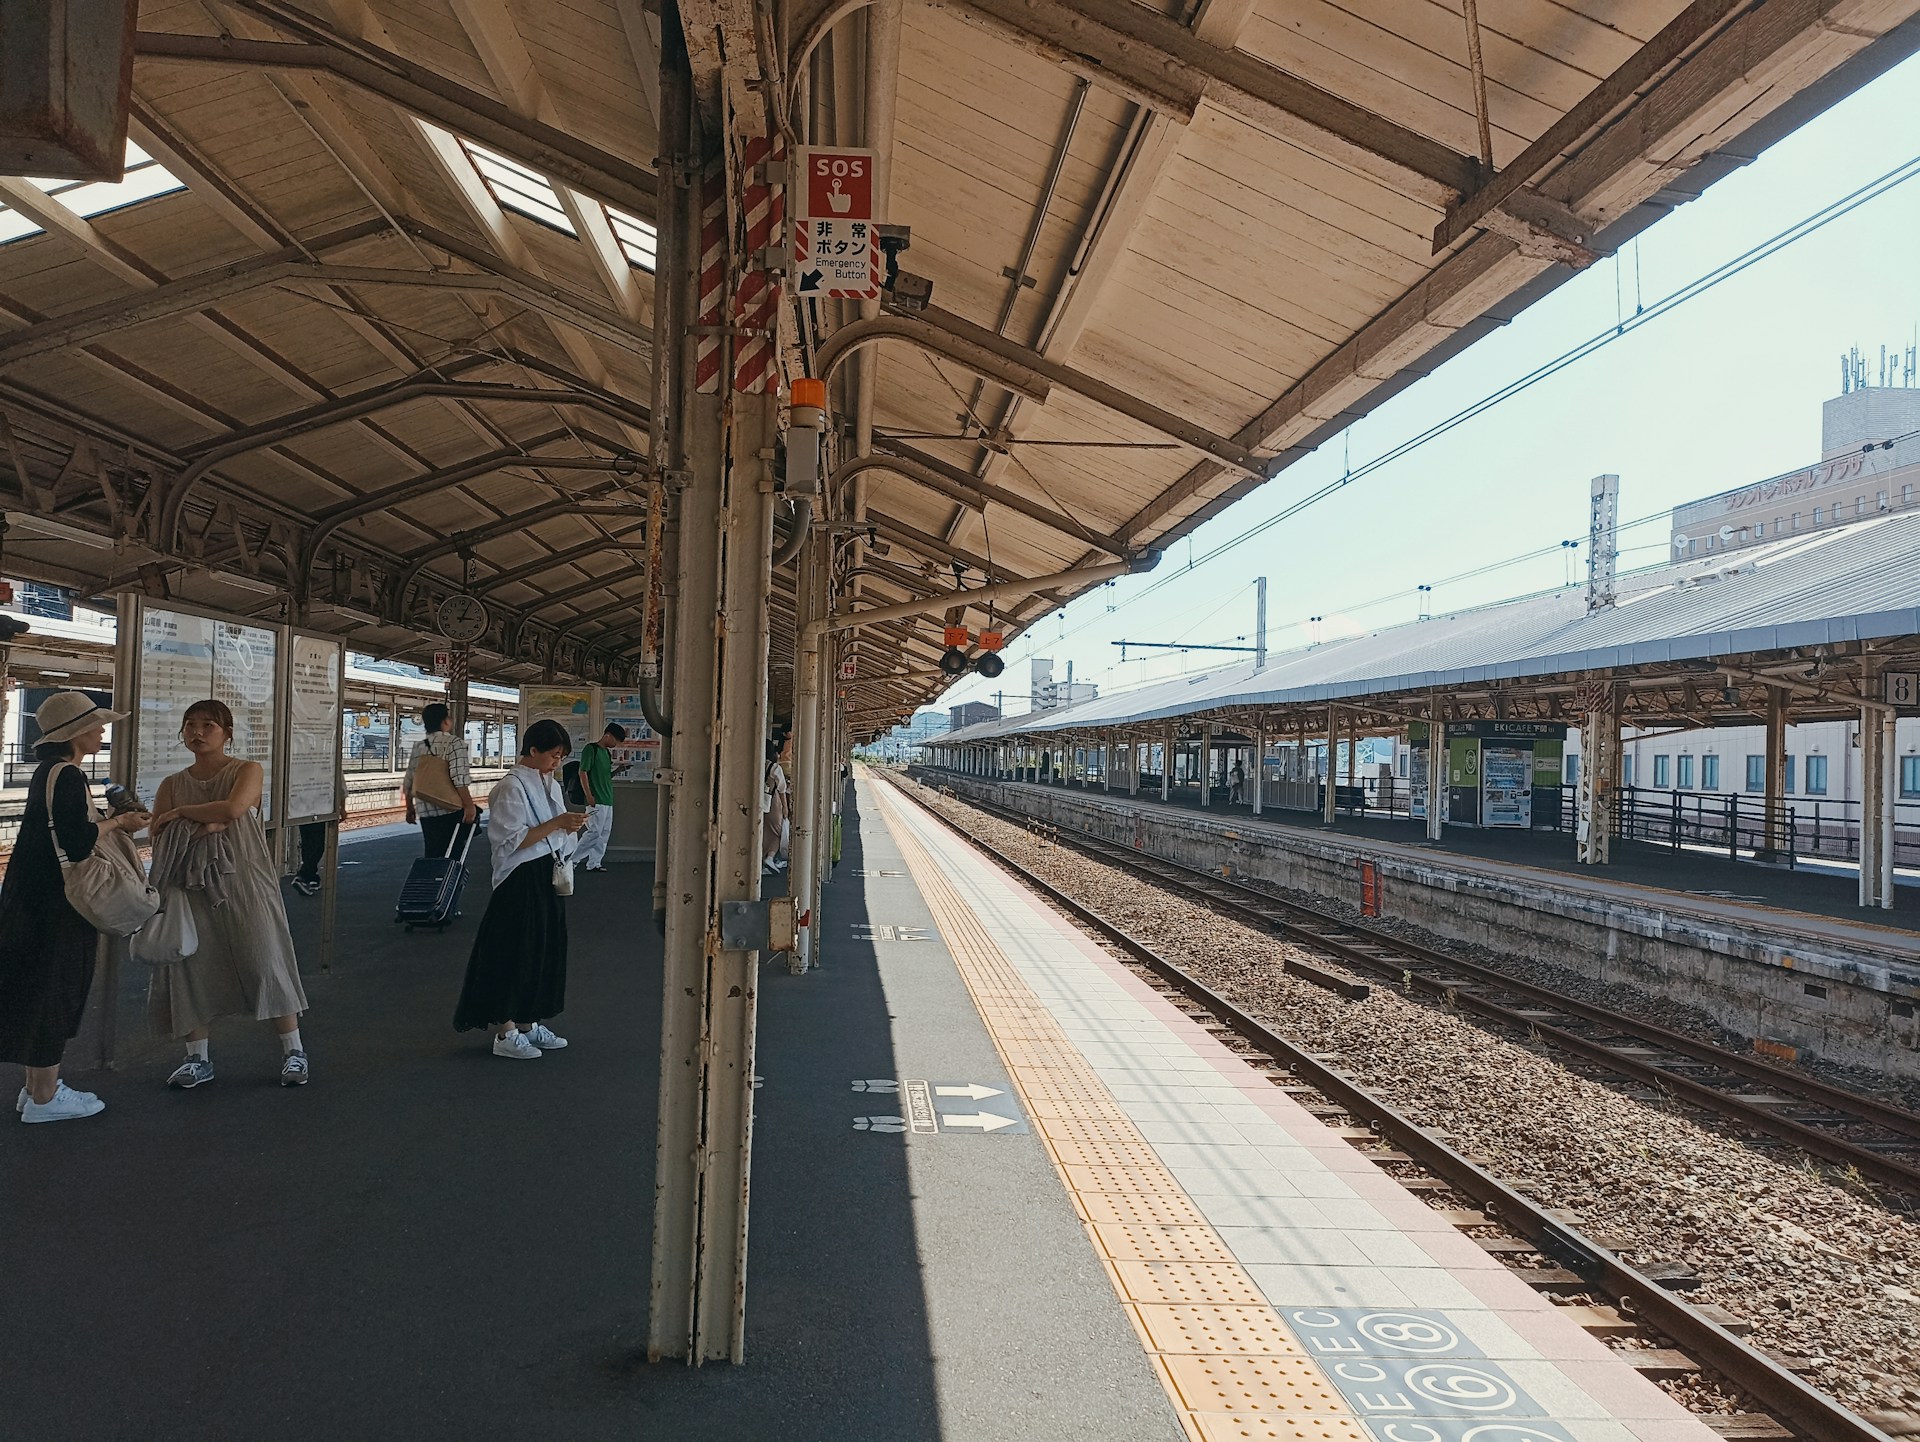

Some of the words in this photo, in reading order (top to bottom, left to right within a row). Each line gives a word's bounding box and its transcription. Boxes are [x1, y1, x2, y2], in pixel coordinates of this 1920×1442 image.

[817, 159, 863, 178] SOS
[816, 239, 866, 256] ボタン
[815, 257, 867, 269] Emergency
[835, 268, 867, 280] Button
[1894, 676, 1909, 702] 8
